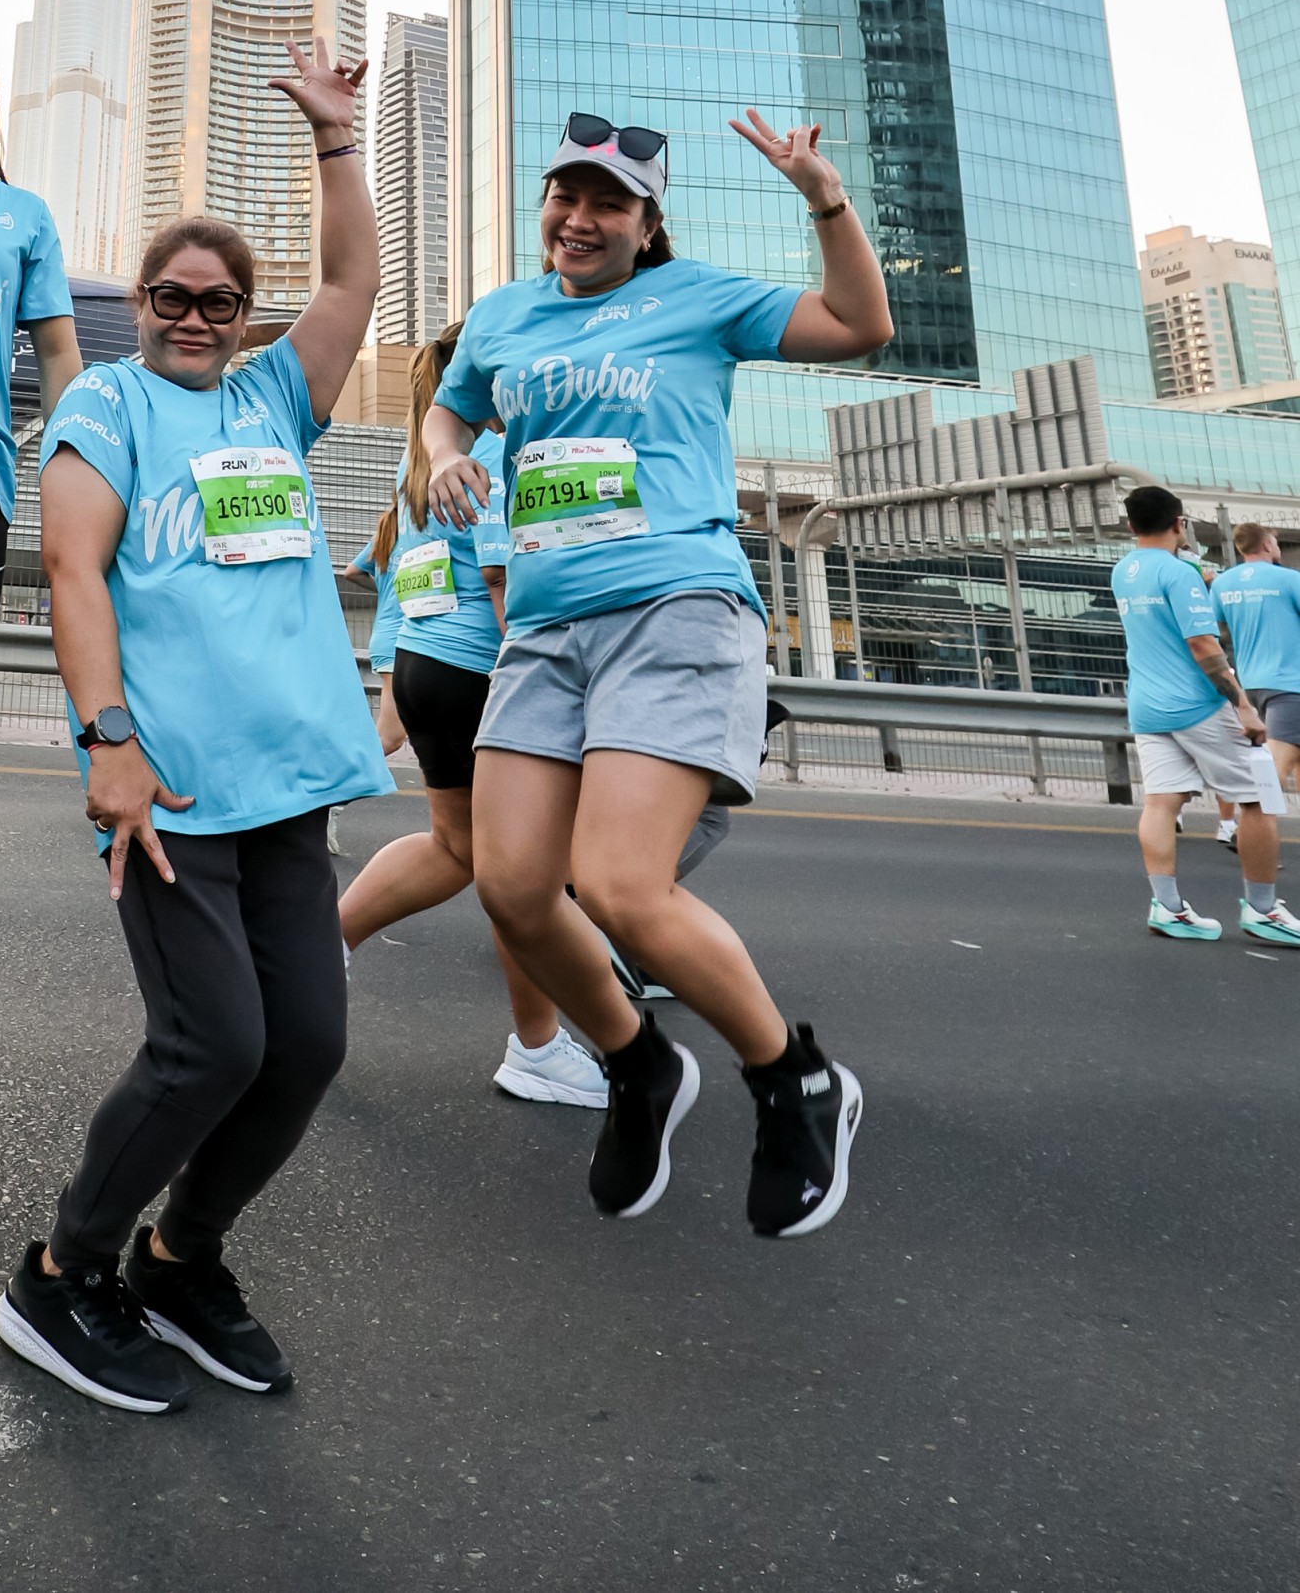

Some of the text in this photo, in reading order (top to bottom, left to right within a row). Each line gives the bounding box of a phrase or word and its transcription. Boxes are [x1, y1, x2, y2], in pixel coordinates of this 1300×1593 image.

[1235, 249, 1272, 262] EMAAR
[1150, 261, 1184, 279] EMAAR
[598, 304, 630, 313] DUBAI
[585, 310, 630, 330] RUN
[532, 352, 657, 412] Dubai
[598, 403, 622, 412] water
[624, 404, 632, 413] is
[53, 413, 120, 447] DP WORLD
[222, 460, 247, 470] RUN
[522, 451, 545, 465] RUN
[599, 470, 621, 478] 10KM
[516, 480, 589, 512] 167191
[217, 494, 287, 519] 167190
[594, 517, 618, 526] WORLD
[397, 573, 429, 594] 130220
